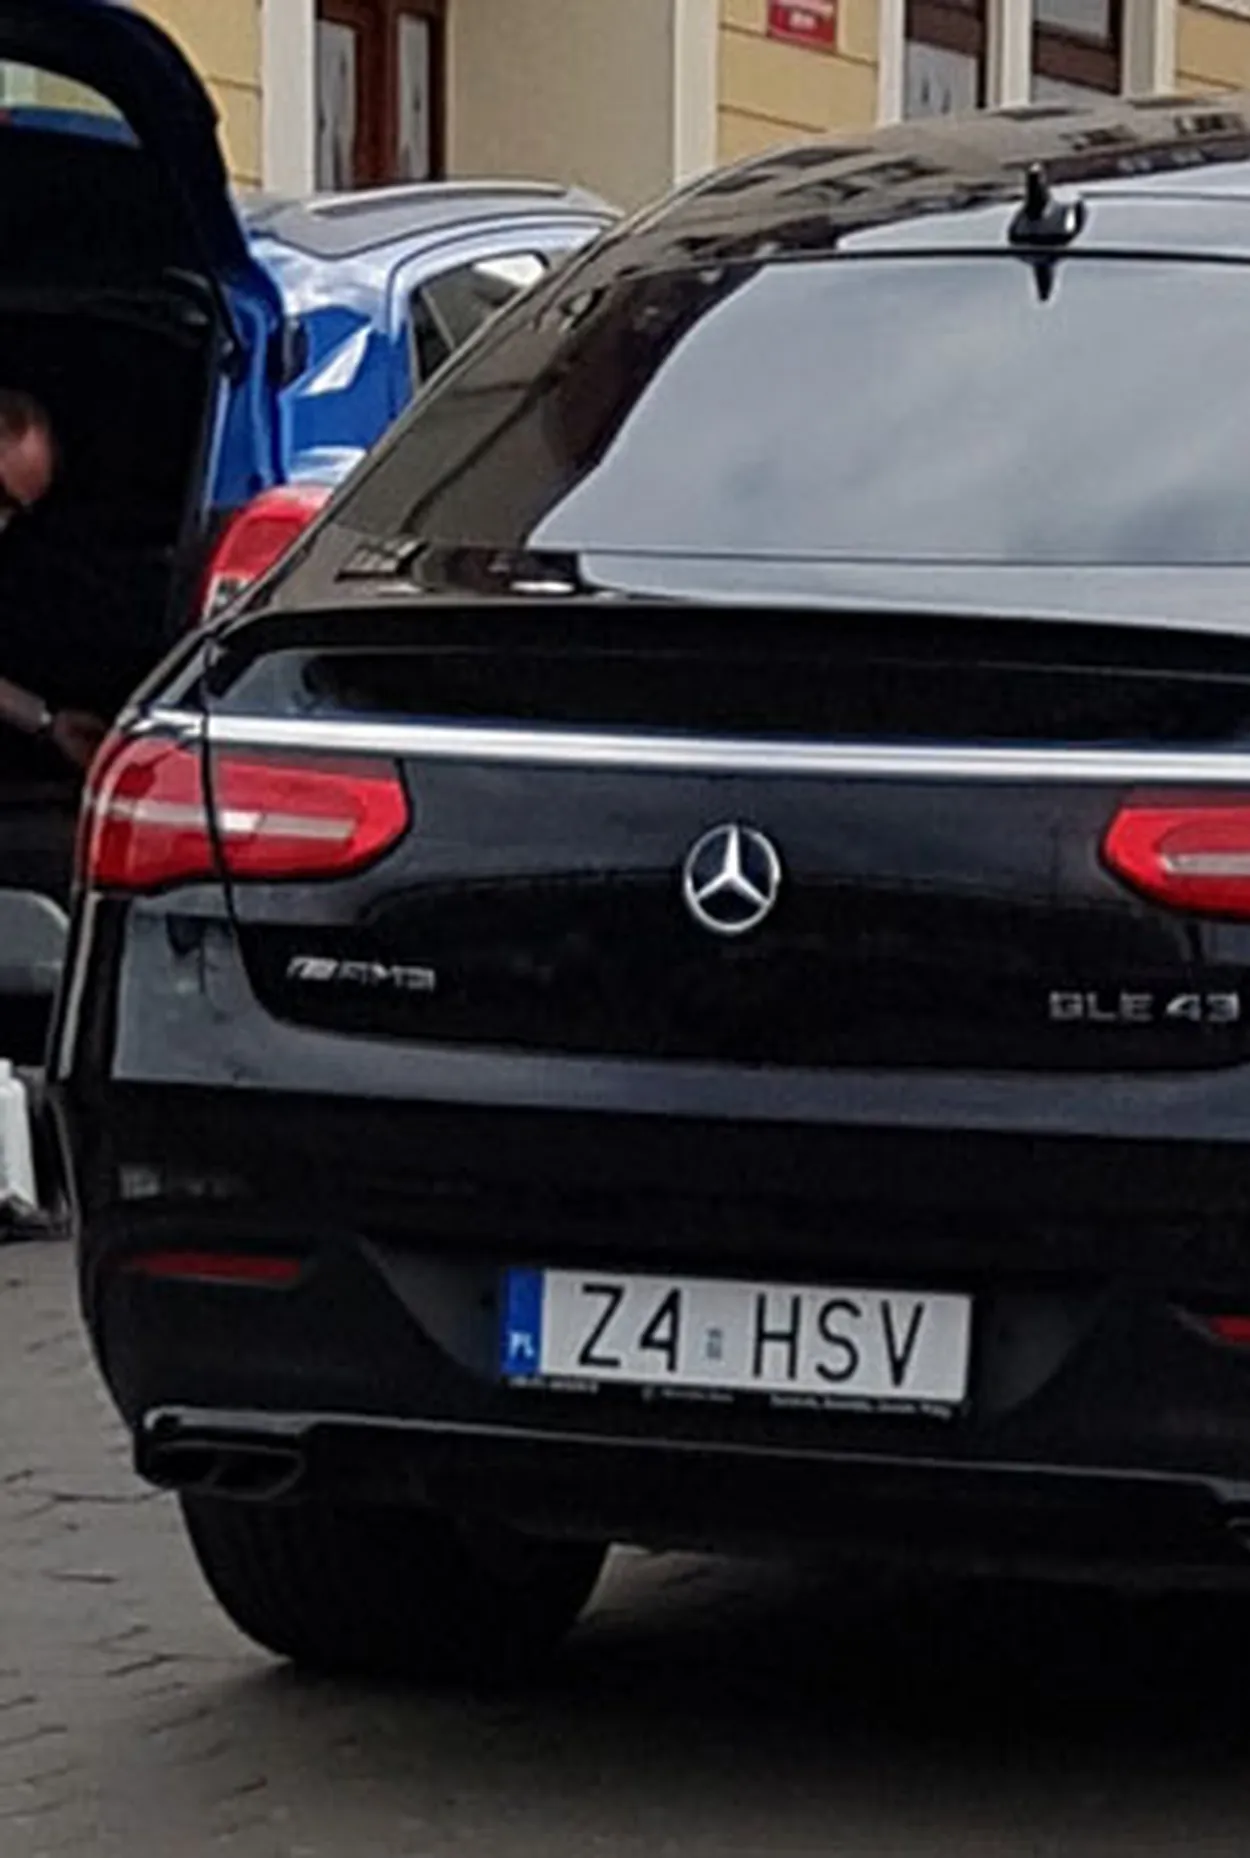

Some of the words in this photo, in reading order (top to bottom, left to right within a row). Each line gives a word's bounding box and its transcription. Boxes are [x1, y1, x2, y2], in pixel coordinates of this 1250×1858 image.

[338, 961, 435, 992] AMG
[1050, 991, 1153, 1021] GLE
[1166, 992, 1239, 1022] 43
[577, 1283, 683, 1373] Z4
[752, 1292, 924, 1388] HSV
